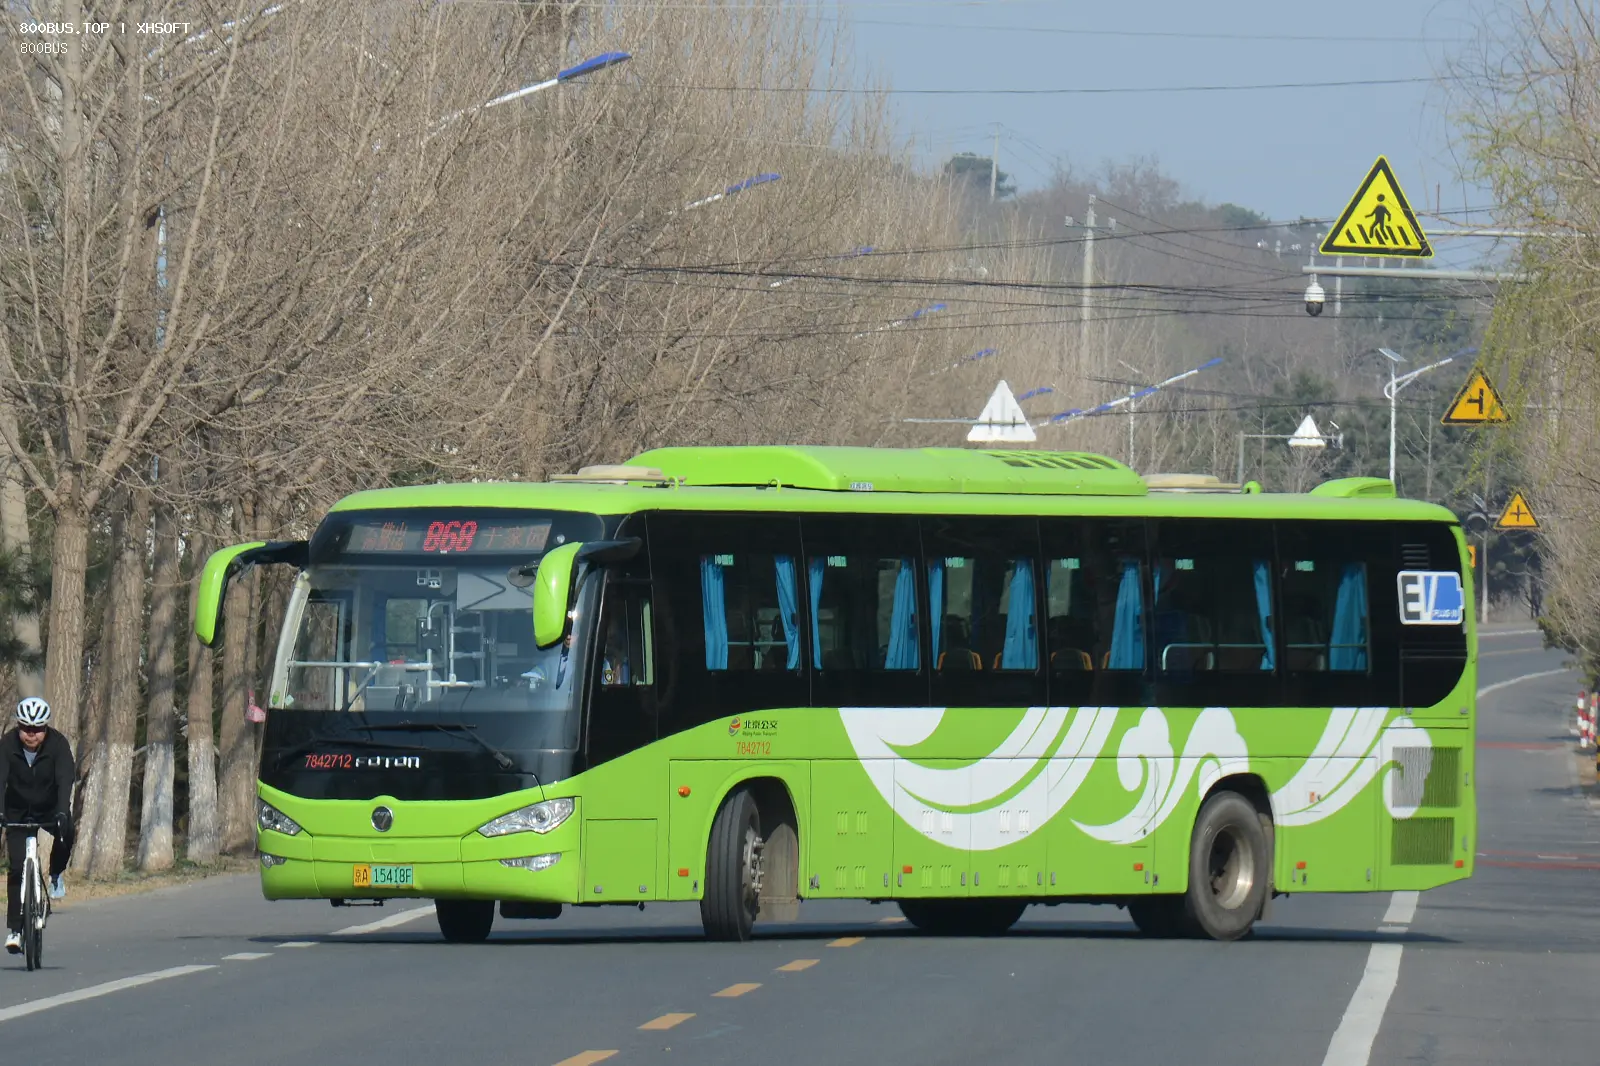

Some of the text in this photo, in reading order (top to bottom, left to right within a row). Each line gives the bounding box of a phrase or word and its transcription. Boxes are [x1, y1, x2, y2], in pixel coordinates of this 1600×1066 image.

[423, 520, 478, 551] 868
[1400, 575, 1438, 621] EV
[743, 719, 778, 730] 北京公交
[736, 741, 771, 755] 7842712
[305, 754, 420, 768] 7842712 FOTON
